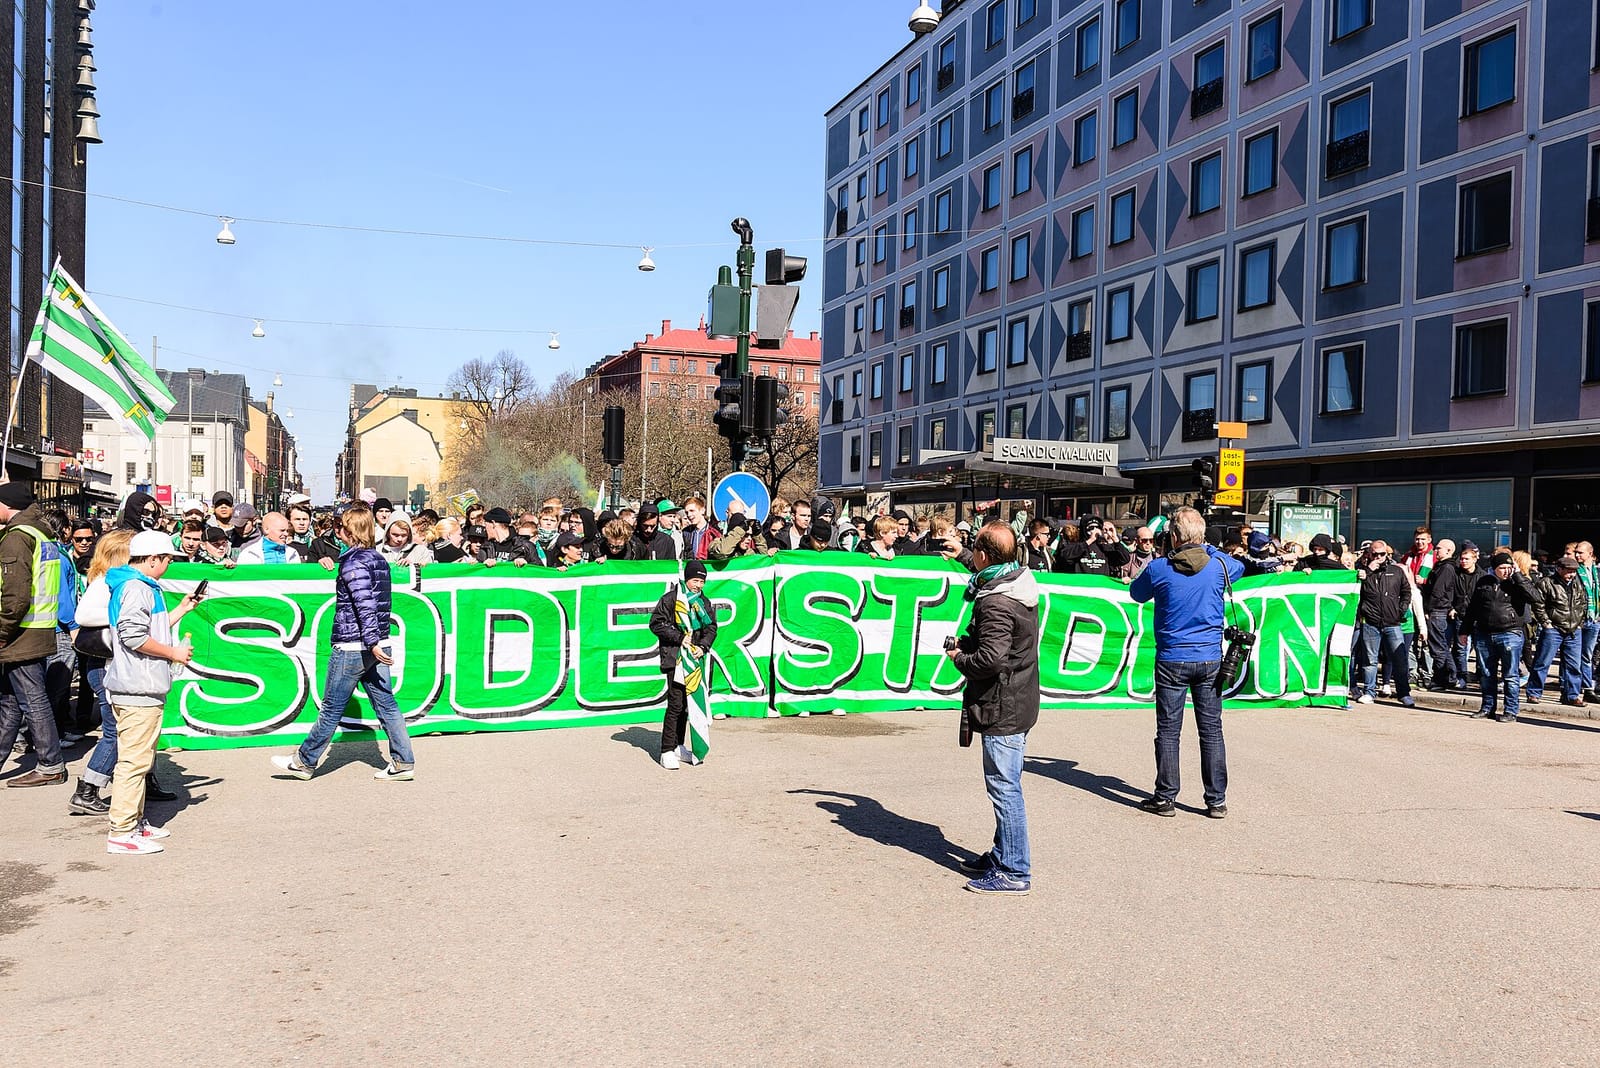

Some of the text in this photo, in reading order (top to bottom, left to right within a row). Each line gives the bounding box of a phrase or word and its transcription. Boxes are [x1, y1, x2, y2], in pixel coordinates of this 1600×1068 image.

[1001, 443, 1113, 462] SCANDIC MALMEN
[178, 563, 1347, 736] SÖDERSTDIN
